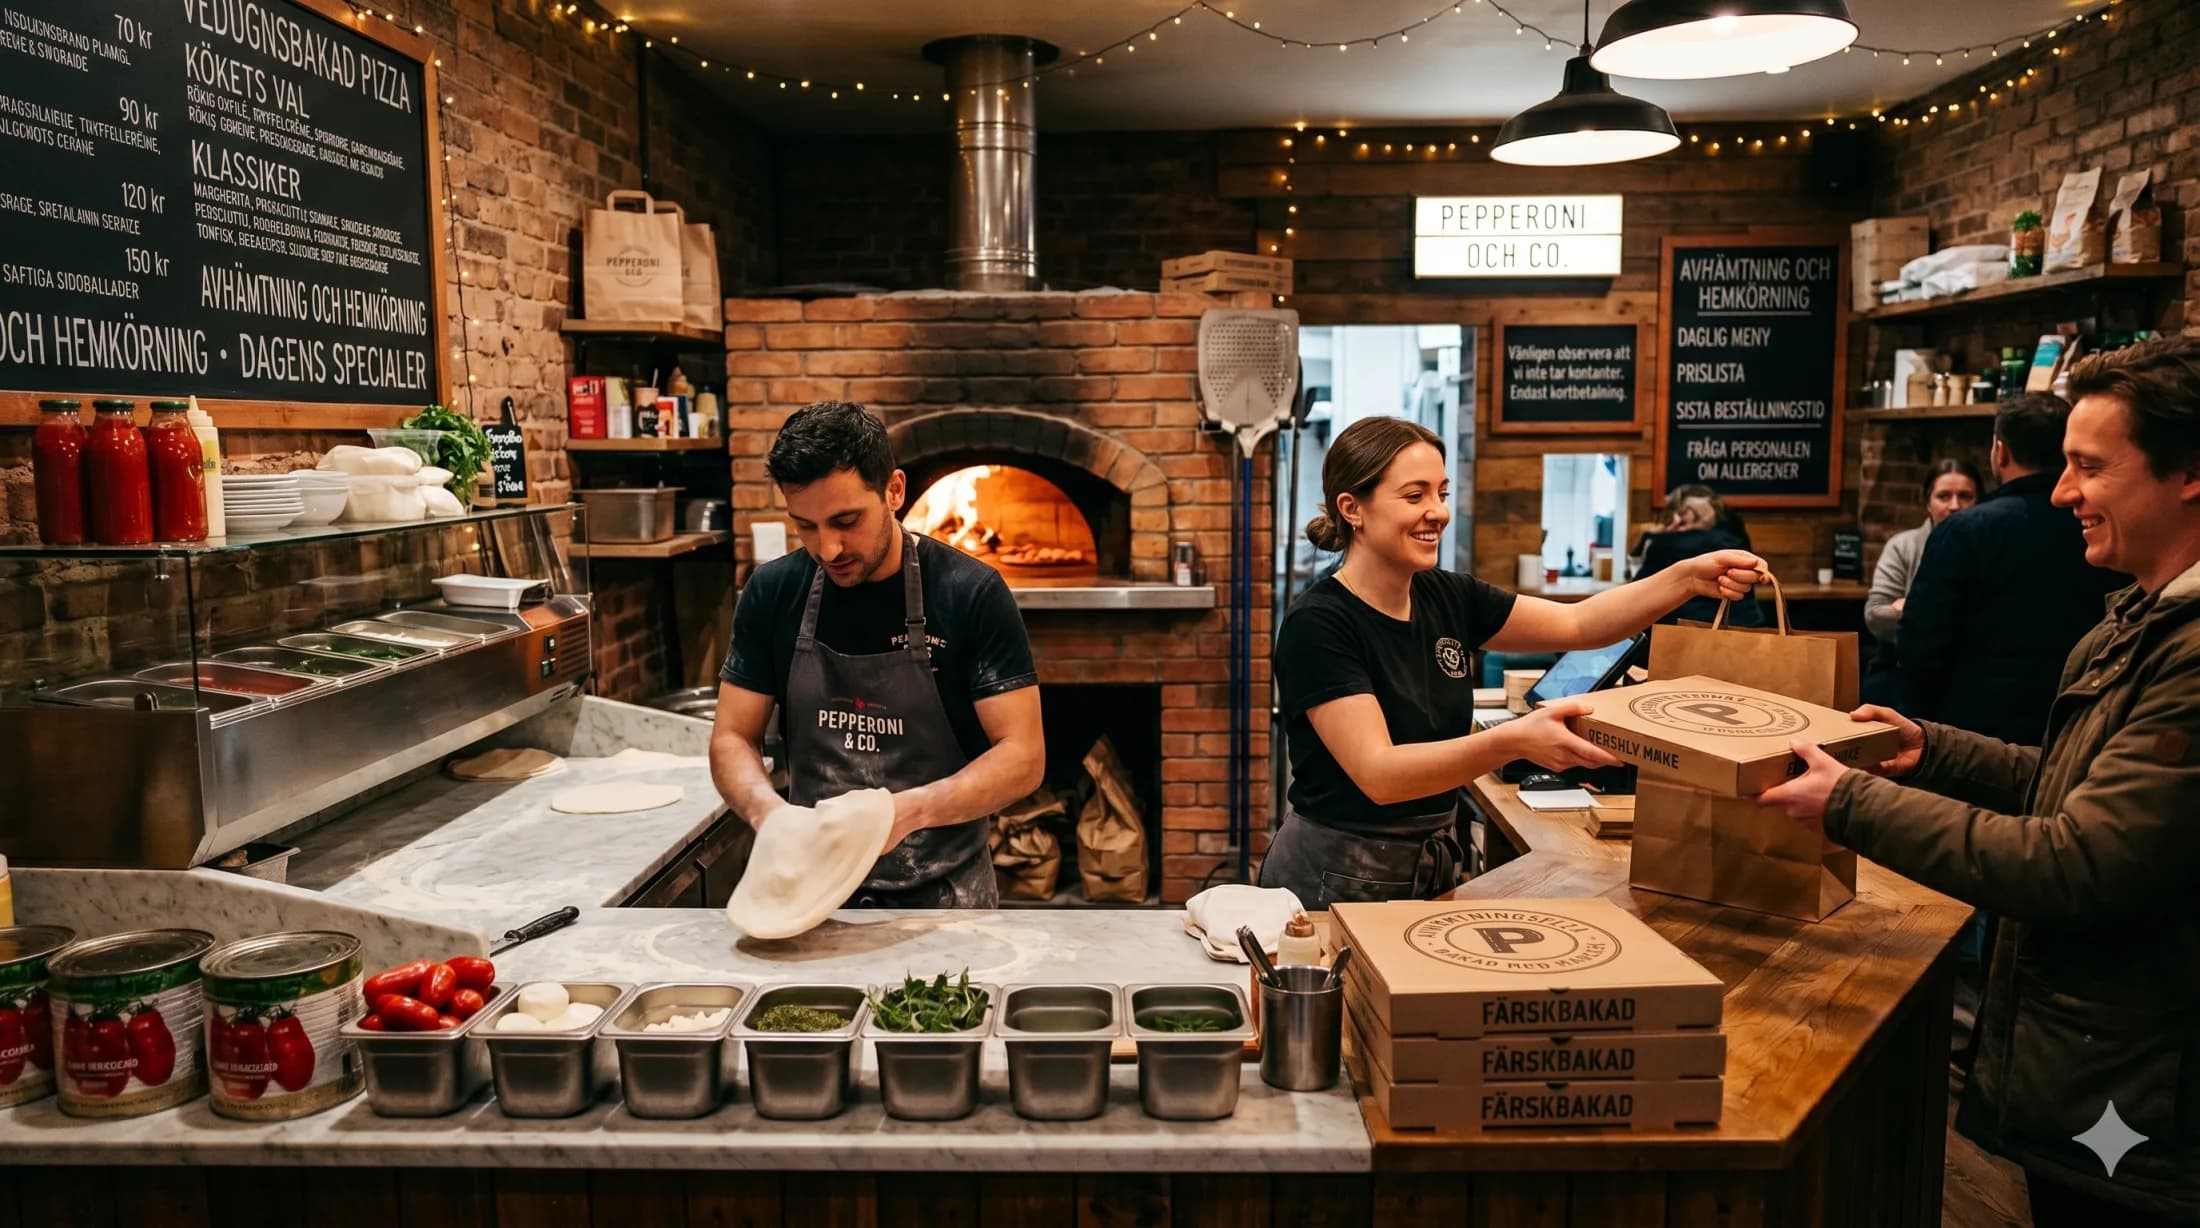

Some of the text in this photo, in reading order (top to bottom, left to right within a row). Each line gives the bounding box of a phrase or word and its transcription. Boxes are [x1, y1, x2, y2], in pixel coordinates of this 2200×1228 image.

[114, 14, 152, 49] 70 kr
[185, 41, 310, 119] KÖKETS VAL
[360, 53, 412, 114] PIZZA
[187, 84, 216, 108] RÖKIG
[120, 96, 158, 131] 90 kr
[192, 139, 302, 201] KLASSIKER
[122, 182, 165, 214] 120 kr
[194, 182, 254, 211] MARGHERITA,
[1442, 204, 1585, 230] PEPPERONI
[196, 222, 237, 247] TONFISK,
[125, 248, 170, 277] 150 kr
[1468, 243, 1568, 268] OCH CO.
[1680, 254, 1831, 282] AVHÄMTNING OCH
[3, 264, 139, 299] SAFTIGA SIDOBALLADER
[201, 261, 308, 321] AVHÄMTNING
[311, 283, 342, 326] OCH
[345, 286, 427, 337] HEMKÖRNING
[1699, 282, 1810, 310] HEMKÖRNING
[1678, 327, 1771, 347] DAGLIG MENY
[54, 312, 208, 375] HEMKÖRNING
[239, 332, 327, 384] DAGENS
[332, 342, 427, 390] SPECIALER
[1508, 344, 1631, 363] Vänligen observera att
[1513, 365, 1625, 380] vi inte tar kontanter.
[1676, 362, 1745, 383] PRISLISTA
[1510, 384, 1548, 400] Endast
[1676, 398, 1825, 420] SISTA BESTÄLLNINGSTID
[1687, 436, 1811, 459] FRÅGA PERSONALEN
[1698, 462, 1799, 480] OM ALLERGENER
[818, 709, 904, 736] PEPPERONI
[1677, 703, 1746, 725] P
[844, 732, 880, 752] & CO.
[1472, 927, 1545, 953] P
[1482, 996, 1636, 1026] FÄRSKBAKAD
[1482, 1045, 1635, 1074] FÄRSKBAKAD
[1481, 1093, 1633, 1120] FÄRSKBAKAD
